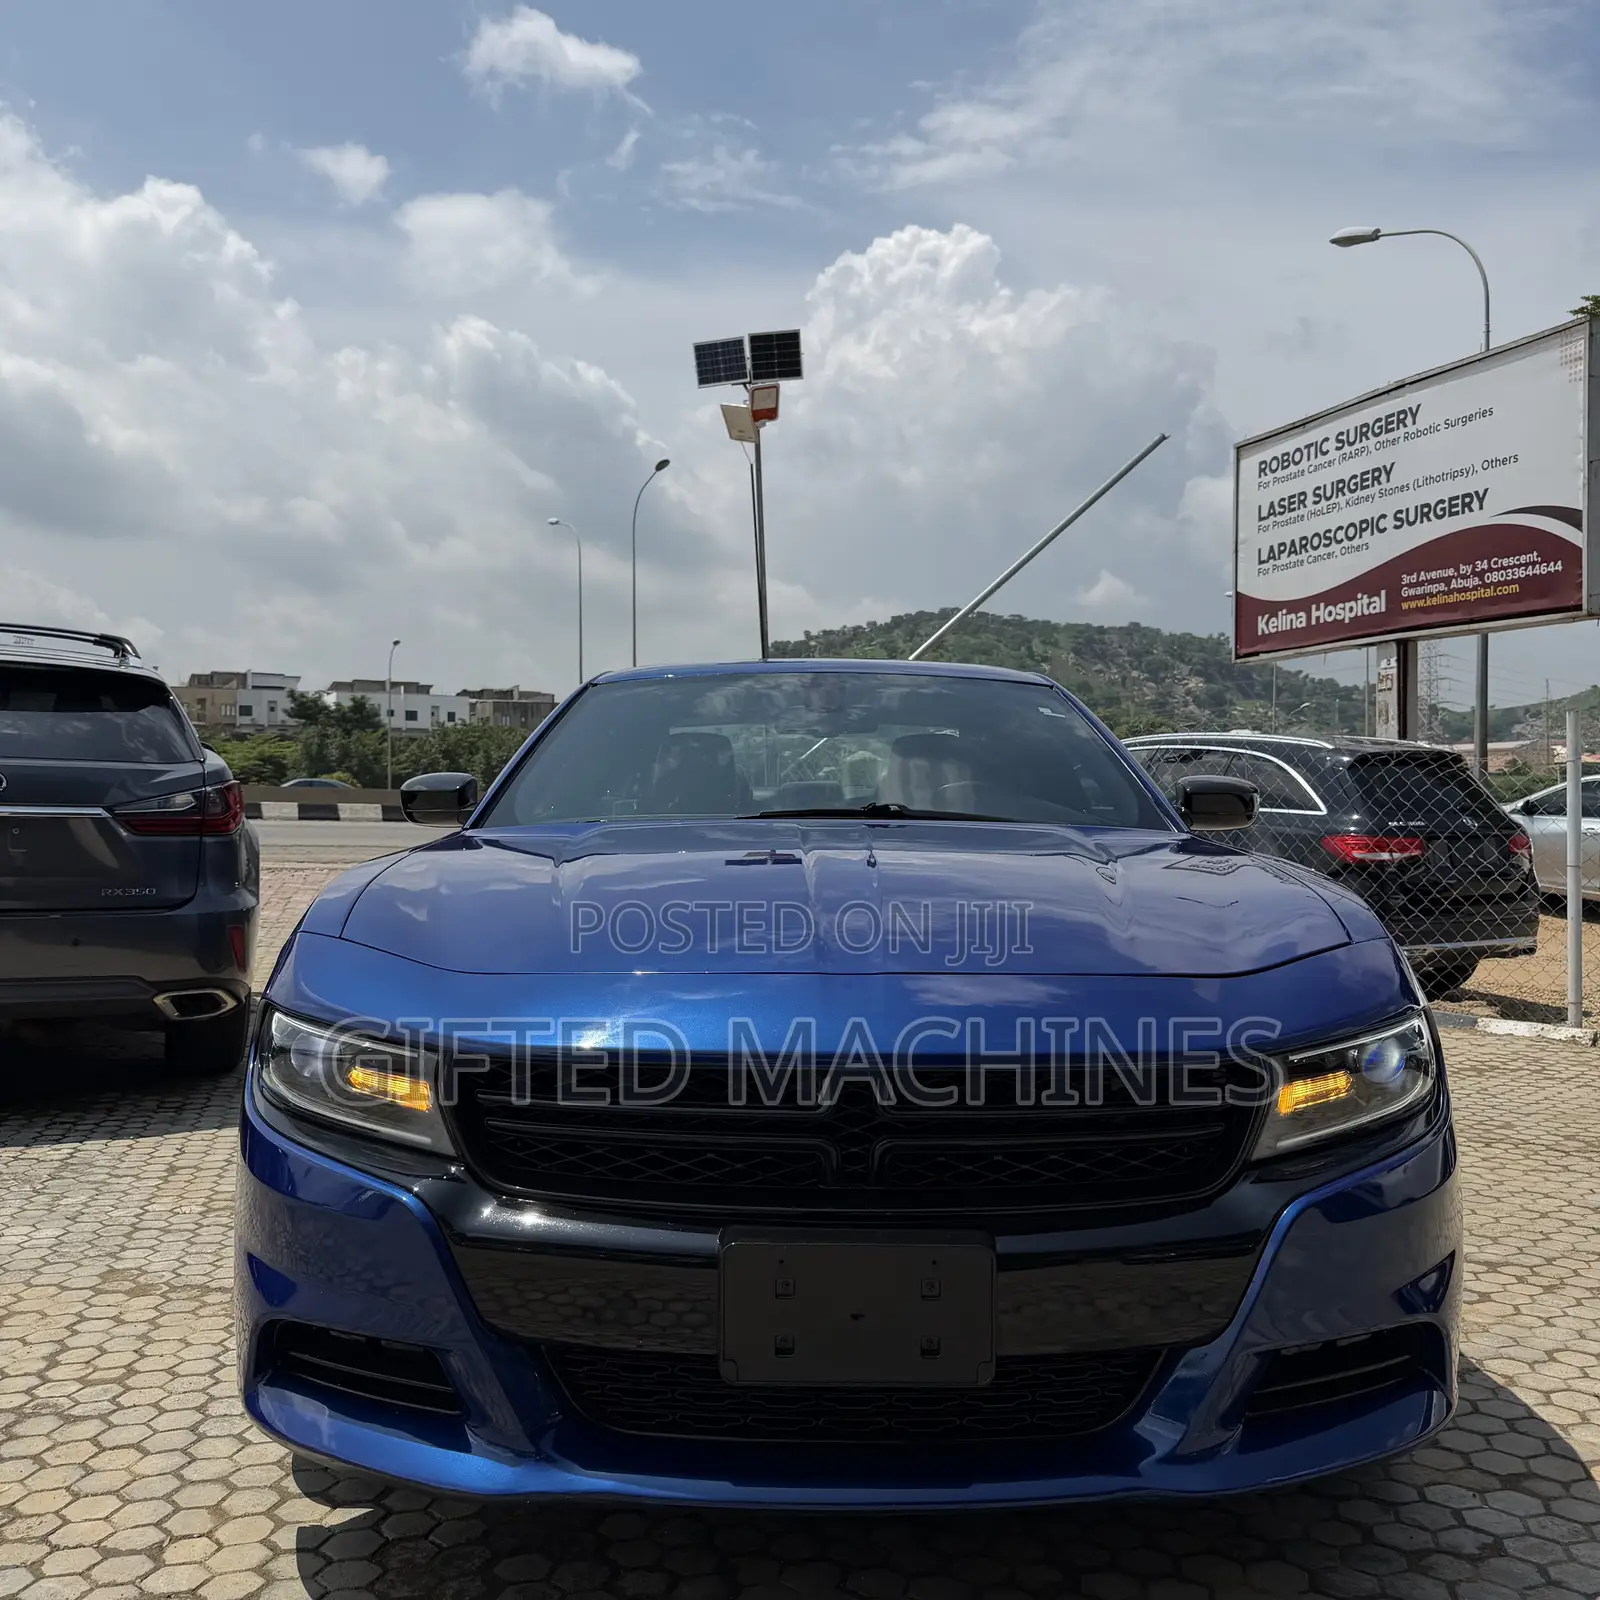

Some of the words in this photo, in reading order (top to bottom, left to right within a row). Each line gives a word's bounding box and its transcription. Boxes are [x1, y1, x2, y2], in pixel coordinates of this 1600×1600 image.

[1258, 437, 1330, 478] ROBOTIC
[1335, 403, 1422, 451] SURGERY
[1258, 478, 1271, 491] For
[1272, 468, 1305, 485] Prostate
[1307, 457, 1336, 474] Cancer
[1338, 445, 1372, 465] (RARP),
[1374, 436, 1401, 451] Other
[1403, 422, 1441, 442] Robotic
[1443, 406, 1494, 430] Surgeries
[1258, 491, 1307, 522] LASER
[1312, 462, 1396, 505] SURGERY
[1258, 523, 1271, 534] For
[1272, 512, 1305, 530] Prostate
[1306, 501, 1343, 521] (HoLEP),
[1345, 492, 1376, 509] Kidney
[1378, 482, 1410, 499] Stones
[1412, 463, 1478, 491] (Lithotripsy),
[1481, 453, 1519, 471] Others
[1258, 513, 1388, 566] LAPAROSCOPIC
[1393, 487, 1489, 530] SURGERY
[1258, 567, 1270, 578] For
[1272, 557, 1305, 574] Prostate
[1306, 551, 1338, 565] Cancer,
[1340, 542, 1369, 556] Others
[1401, 573, 1417, 585] 3rd
[1418, 566, 1458, 582] Avenue,
[1459, 564, 1473, 576] by
[1474, 559, 1489, 572] 34
[1490, 550, 1541, 569] Crescent,
[1401, 582, 1448, 598] Gwarinpa,
[1450, 574, 1482, 590] Abuja.
[1484, 560, 1563, 584] 08033644644
[1257, 608, 1307, 636] Kelina
[1311, 589, 1387, 626] Hospital
[1401, 583, 1519, 611] www.kelinahospital.com
